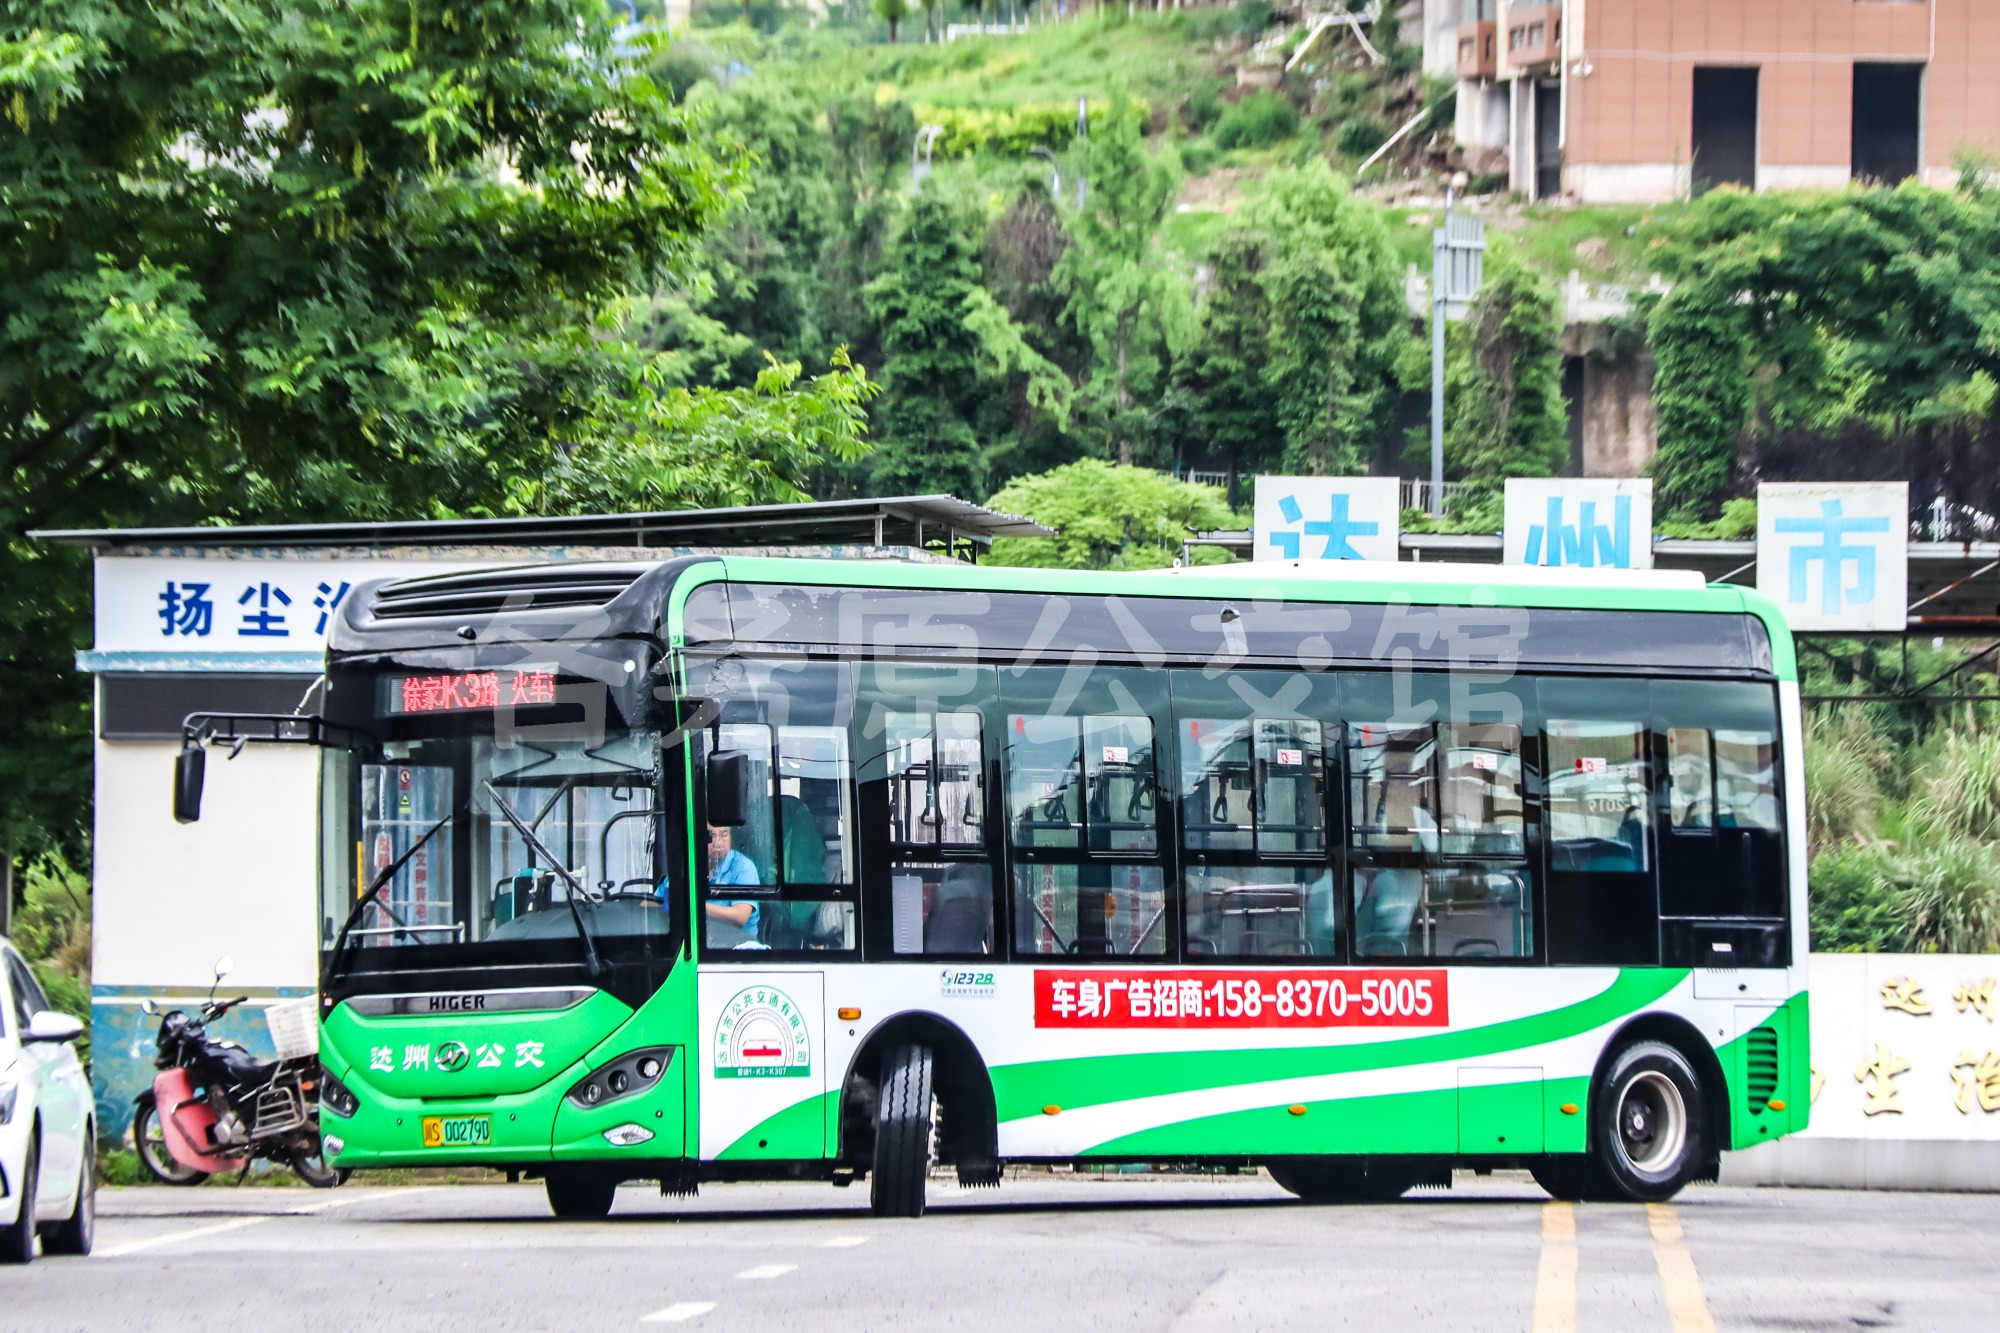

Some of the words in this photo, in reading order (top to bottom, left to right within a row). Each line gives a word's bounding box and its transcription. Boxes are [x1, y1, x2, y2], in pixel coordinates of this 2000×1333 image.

[1269, 493, 1891, 616] 达州市
[953, 972, 994, 985] 12328
[429, 995, 485, 1010] HIGER
[370, 1045, 429, 1072] 达州
[476, 1040, 545, 1069] 公交
